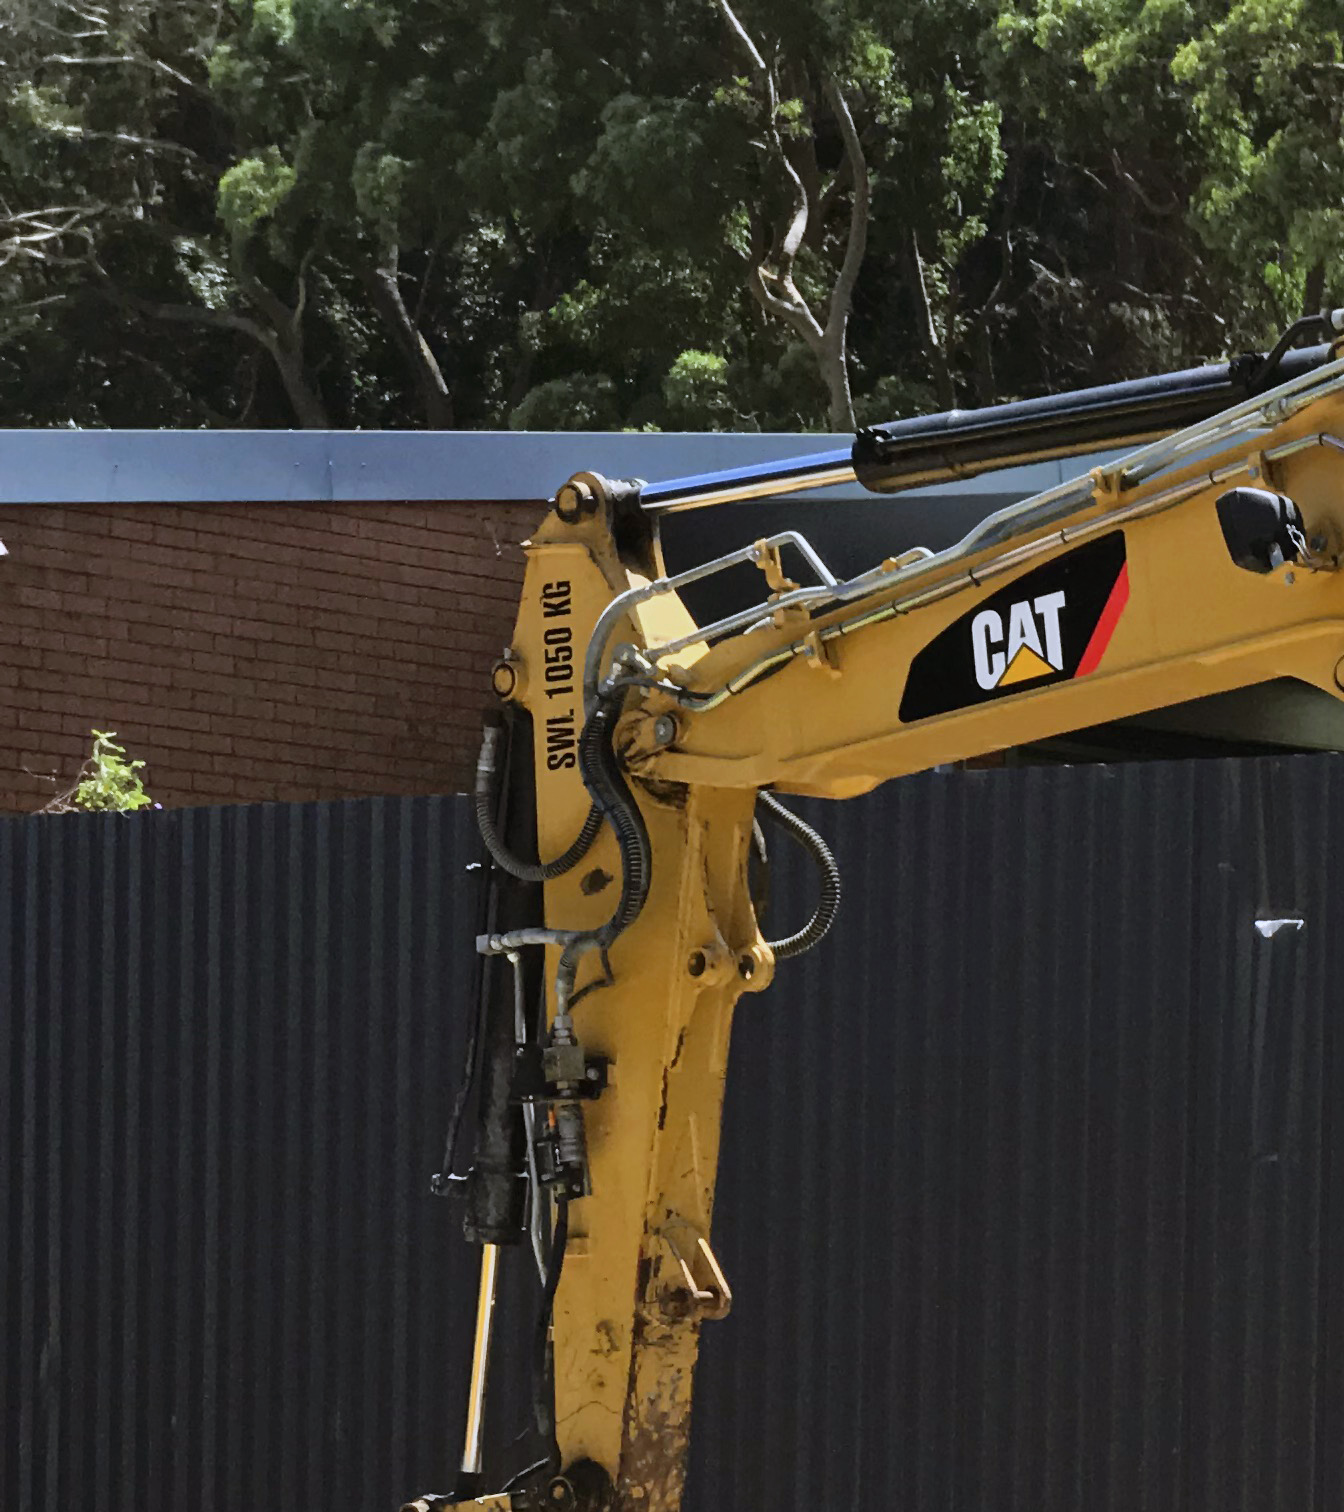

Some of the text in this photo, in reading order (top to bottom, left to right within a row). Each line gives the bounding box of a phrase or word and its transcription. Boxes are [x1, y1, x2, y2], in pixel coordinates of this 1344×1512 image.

[542, 580, 576, 771] SWL 1050 KG
[971, 590, 1066, 690] CAT
